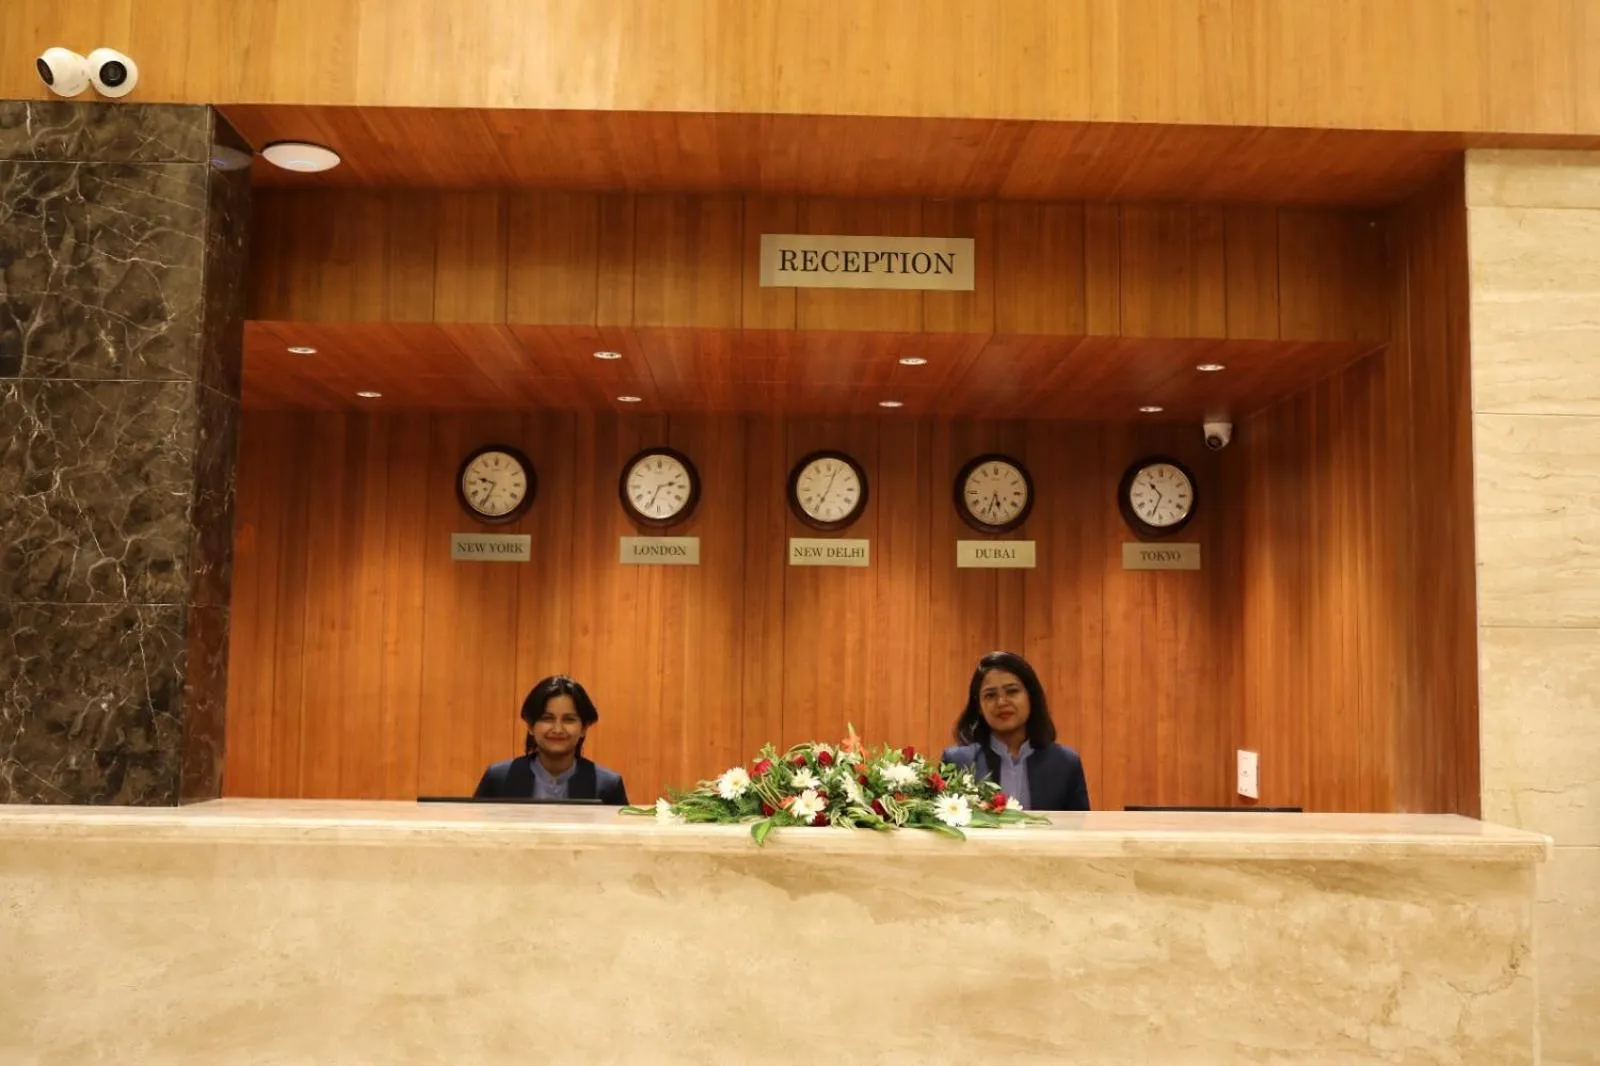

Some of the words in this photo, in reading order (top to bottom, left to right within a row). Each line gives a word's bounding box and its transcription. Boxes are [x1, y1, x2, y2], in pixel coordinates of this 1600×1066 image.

[778, 248, 956, 275] RECEPTION
[457, 541, 486, 554] NEW
[489, 542, 525, 555] YORK
[633, 545, 687, 556] LONDON
[793, 546, 823, 558] NEW
[826, 547, 865, 559] DELHI
[975, 548, 1016, 560] DUBAI
[1139, 550, 1182, 562] TOKYO
